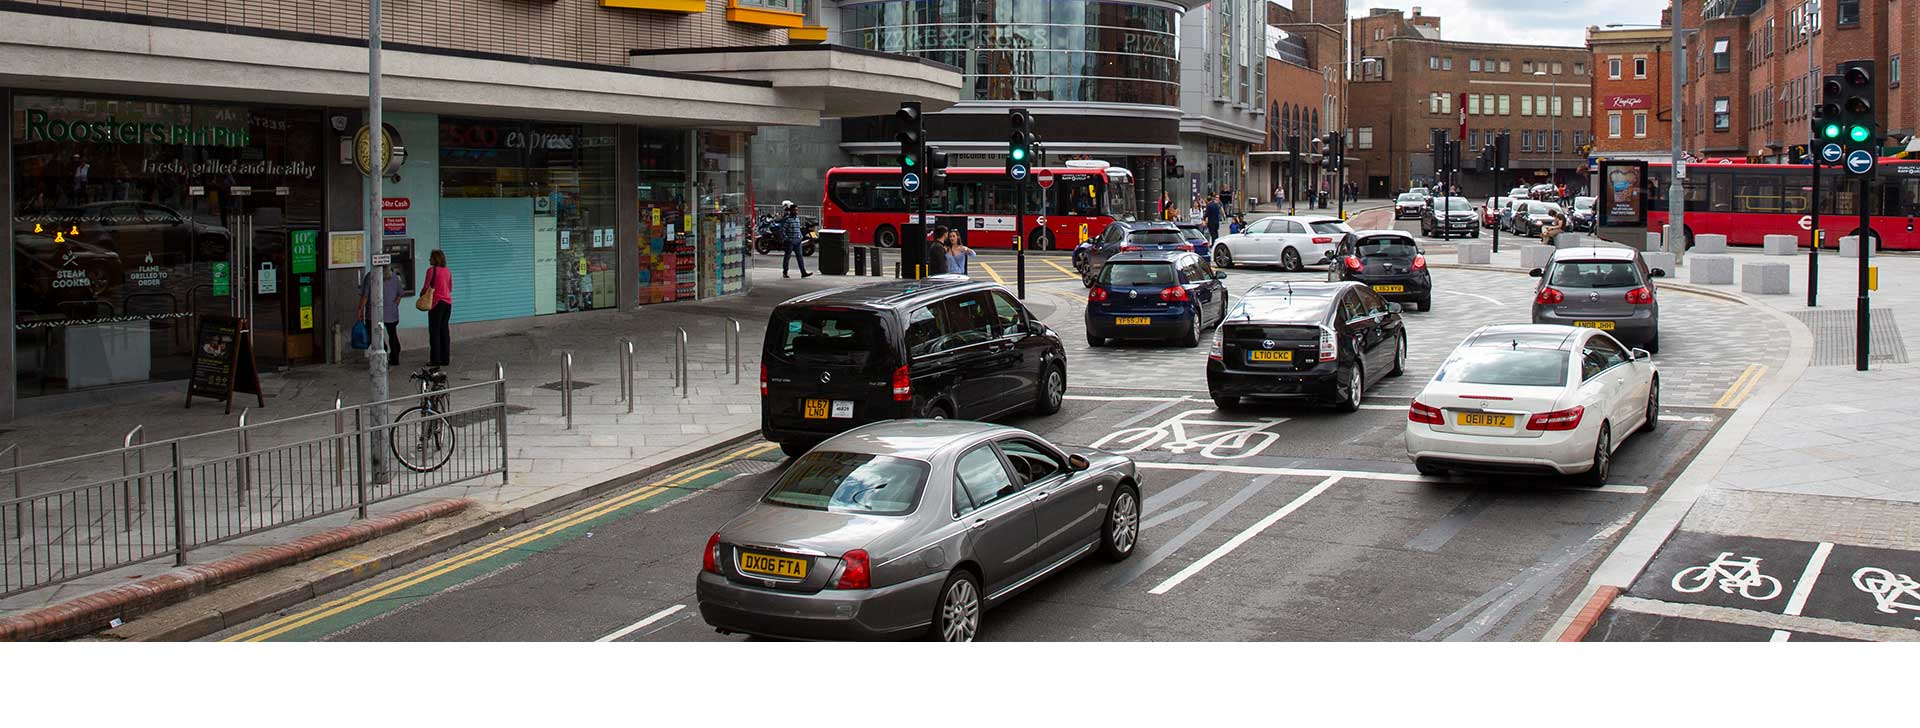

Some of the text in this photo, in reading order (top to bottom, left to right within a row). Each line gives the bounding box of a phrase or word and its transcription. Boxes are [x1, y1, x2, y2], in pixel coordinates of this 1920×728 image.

[25, 108, 165, 145] Roosters
[506, 130, 574, 155] express
[394, 199, 408, 207] Cash
[294, 244, 314, 255] OFF
[139, 265, 160, 273] FLAME
[57, 270, 86, 279] STEAM
[130, 271, 168, 280] GRILLED TO
[52, 278, 91, 288] COOKED
[138, 279, 161, 287] ORDER
[1254, 351, 1289, 360] LT10 CKC
[808, 400, 828, 409] LL67
[1486, 415, 1506, 426] BTZ
[745, 555, 801, 575] DX06 FTA
